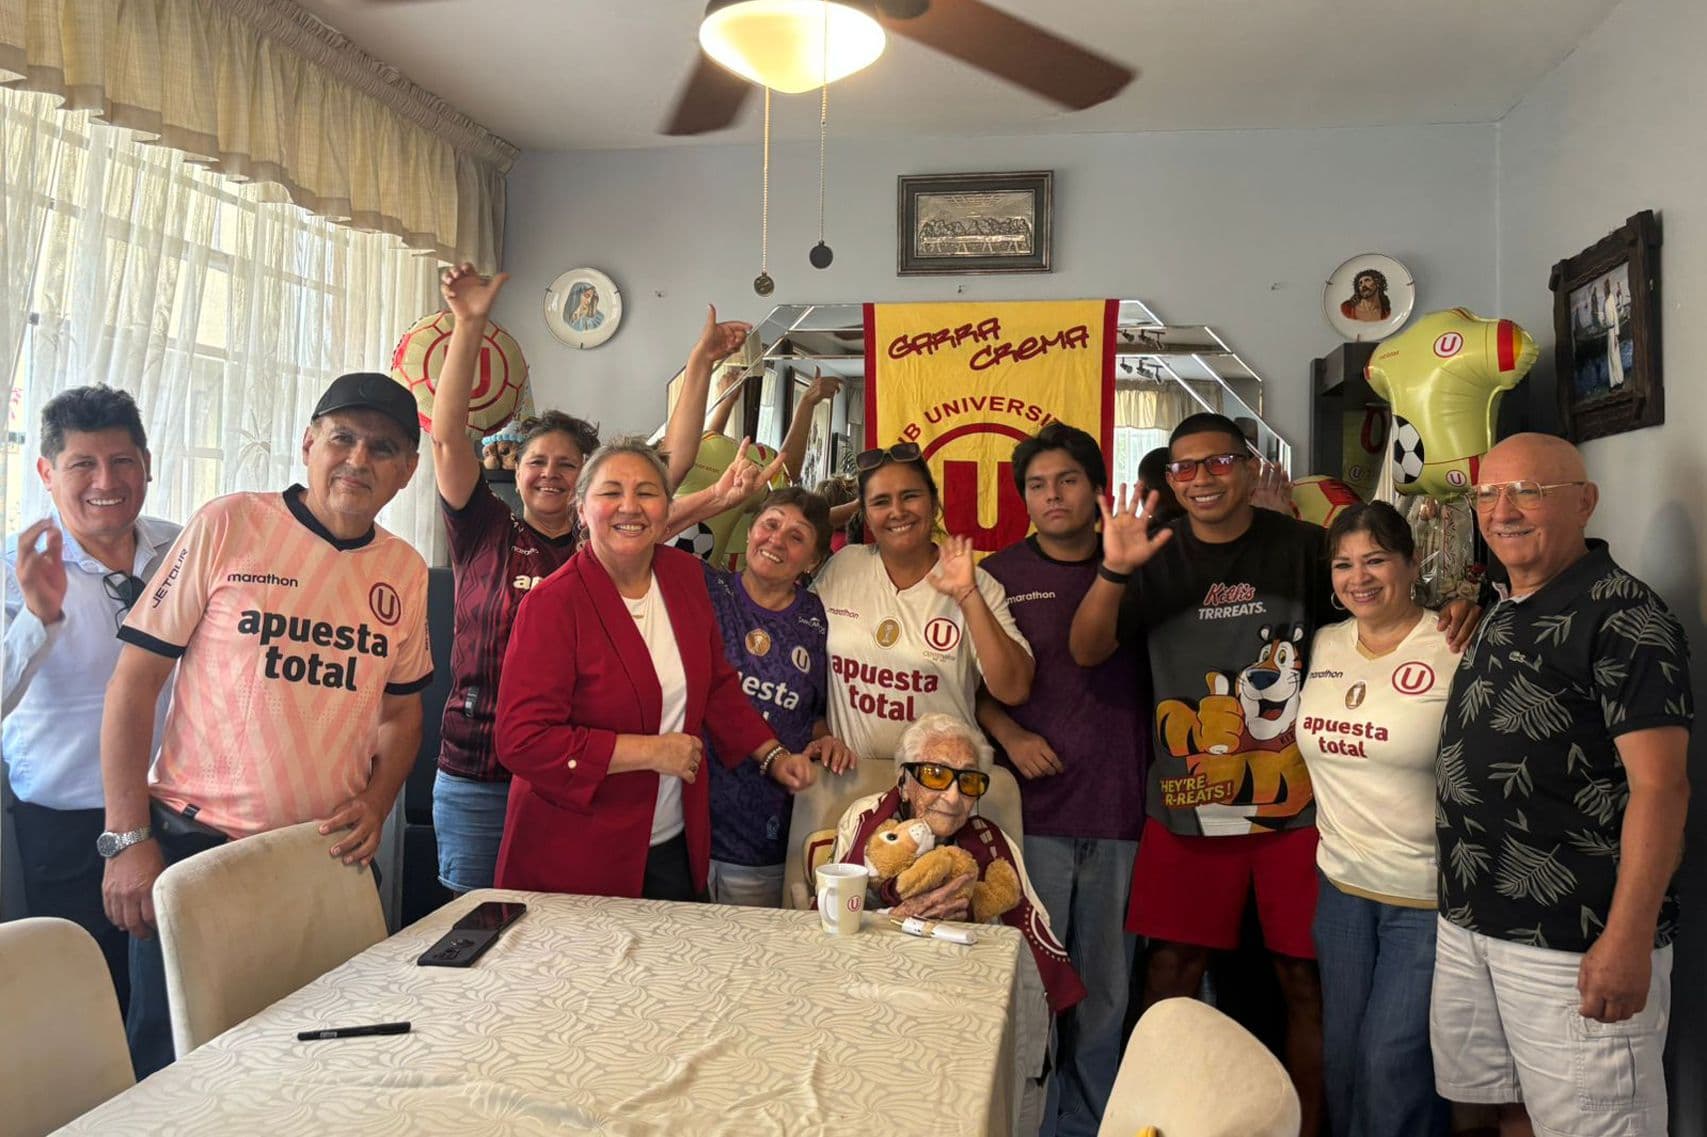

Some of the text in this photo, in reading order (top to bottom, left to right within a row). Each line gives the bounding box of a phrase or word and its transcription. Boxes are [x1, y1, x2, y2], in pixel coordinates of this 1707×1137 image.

[888, 317, 1001, 360] GARRA
[969, 325, 1090, 371] CREMA
[897, 396, 1061, 445] B UNIVERSI
[152, 548, 188, 609] JETOUR
[227, 572, 299, 588] marathon
[1006, 590, 1056, 604] marathon
[1198, 601, 1267, 620] TRRREATS.
[237, 609, 389, 658] apuesta
[264, 646, 358, 692] total
[831, 653, 939, 693] apuesta
[737, 671, 800, 710] esta
[849, 685, 916, 722] total
[1303, 716, 1389, 742] apuesta
[1318, 736, 1368, 759] total
